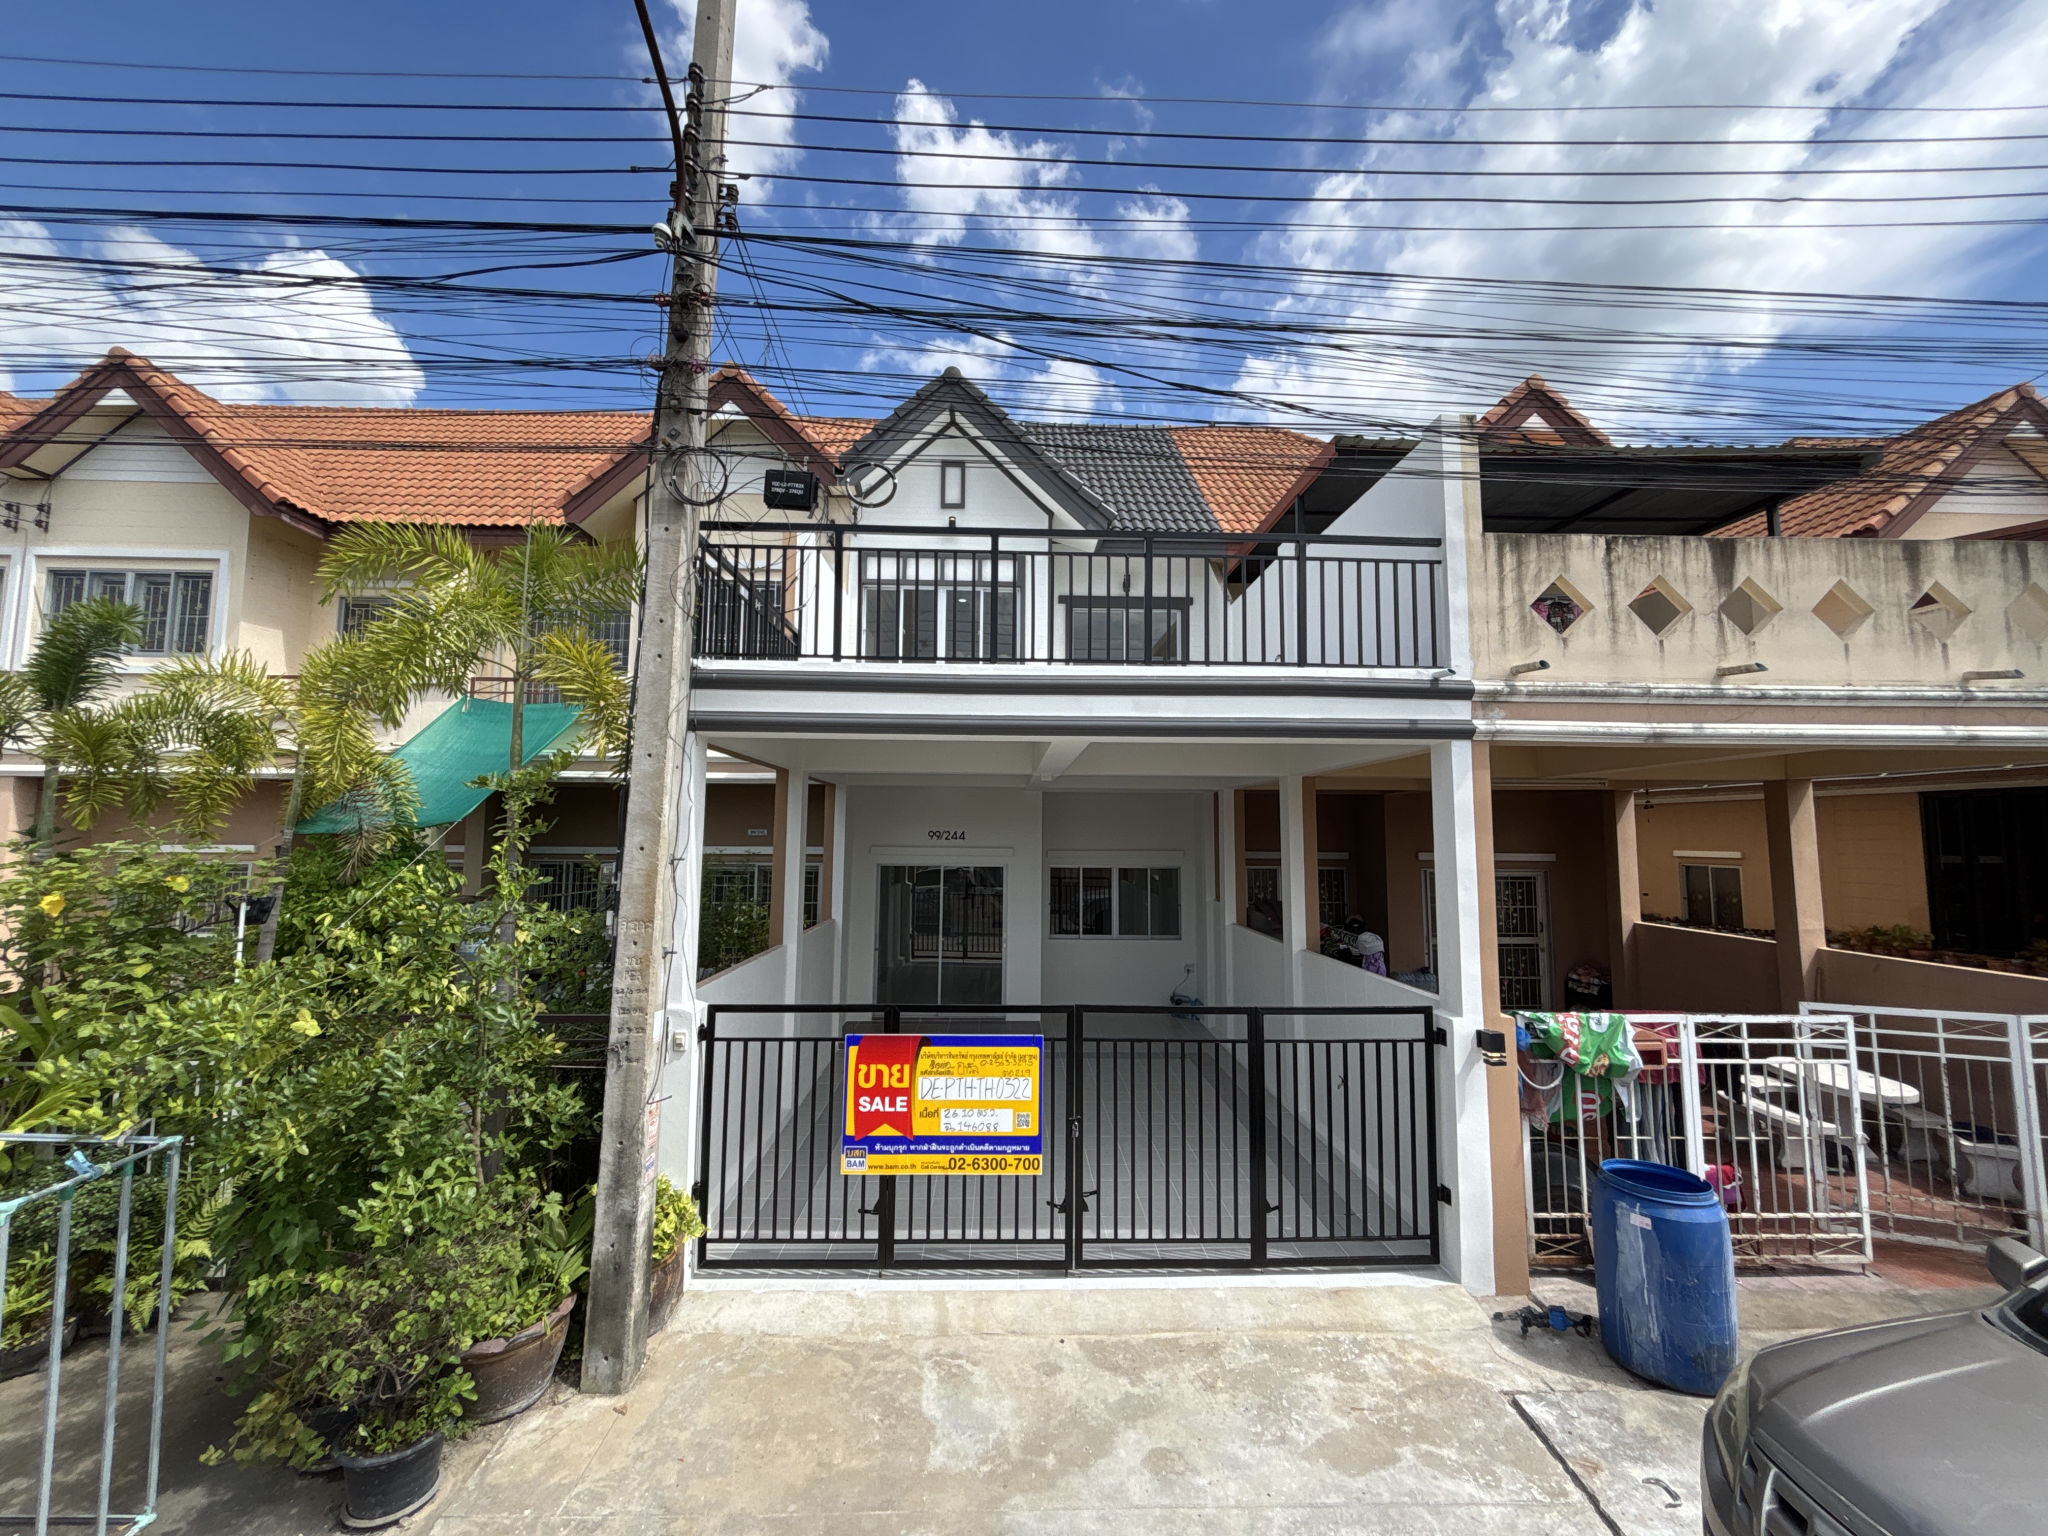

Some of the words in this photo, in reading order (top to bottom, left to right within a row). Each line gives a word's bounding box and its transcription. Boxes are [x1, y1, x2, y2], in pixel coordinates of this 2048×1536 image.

[928, 830, 966, 841] 99/244
[858, 1064, 910, 1089] ขาย
[858, 1096, 908, 1112] SALE
[847, 1149, 866, 1158] บสก
[875, 1143, 907, 1154] ห้ามบุกรุก
[846, 1160, 865, 1168] BAM
[949, 1158, 1040, 1170] 02-6300-700
